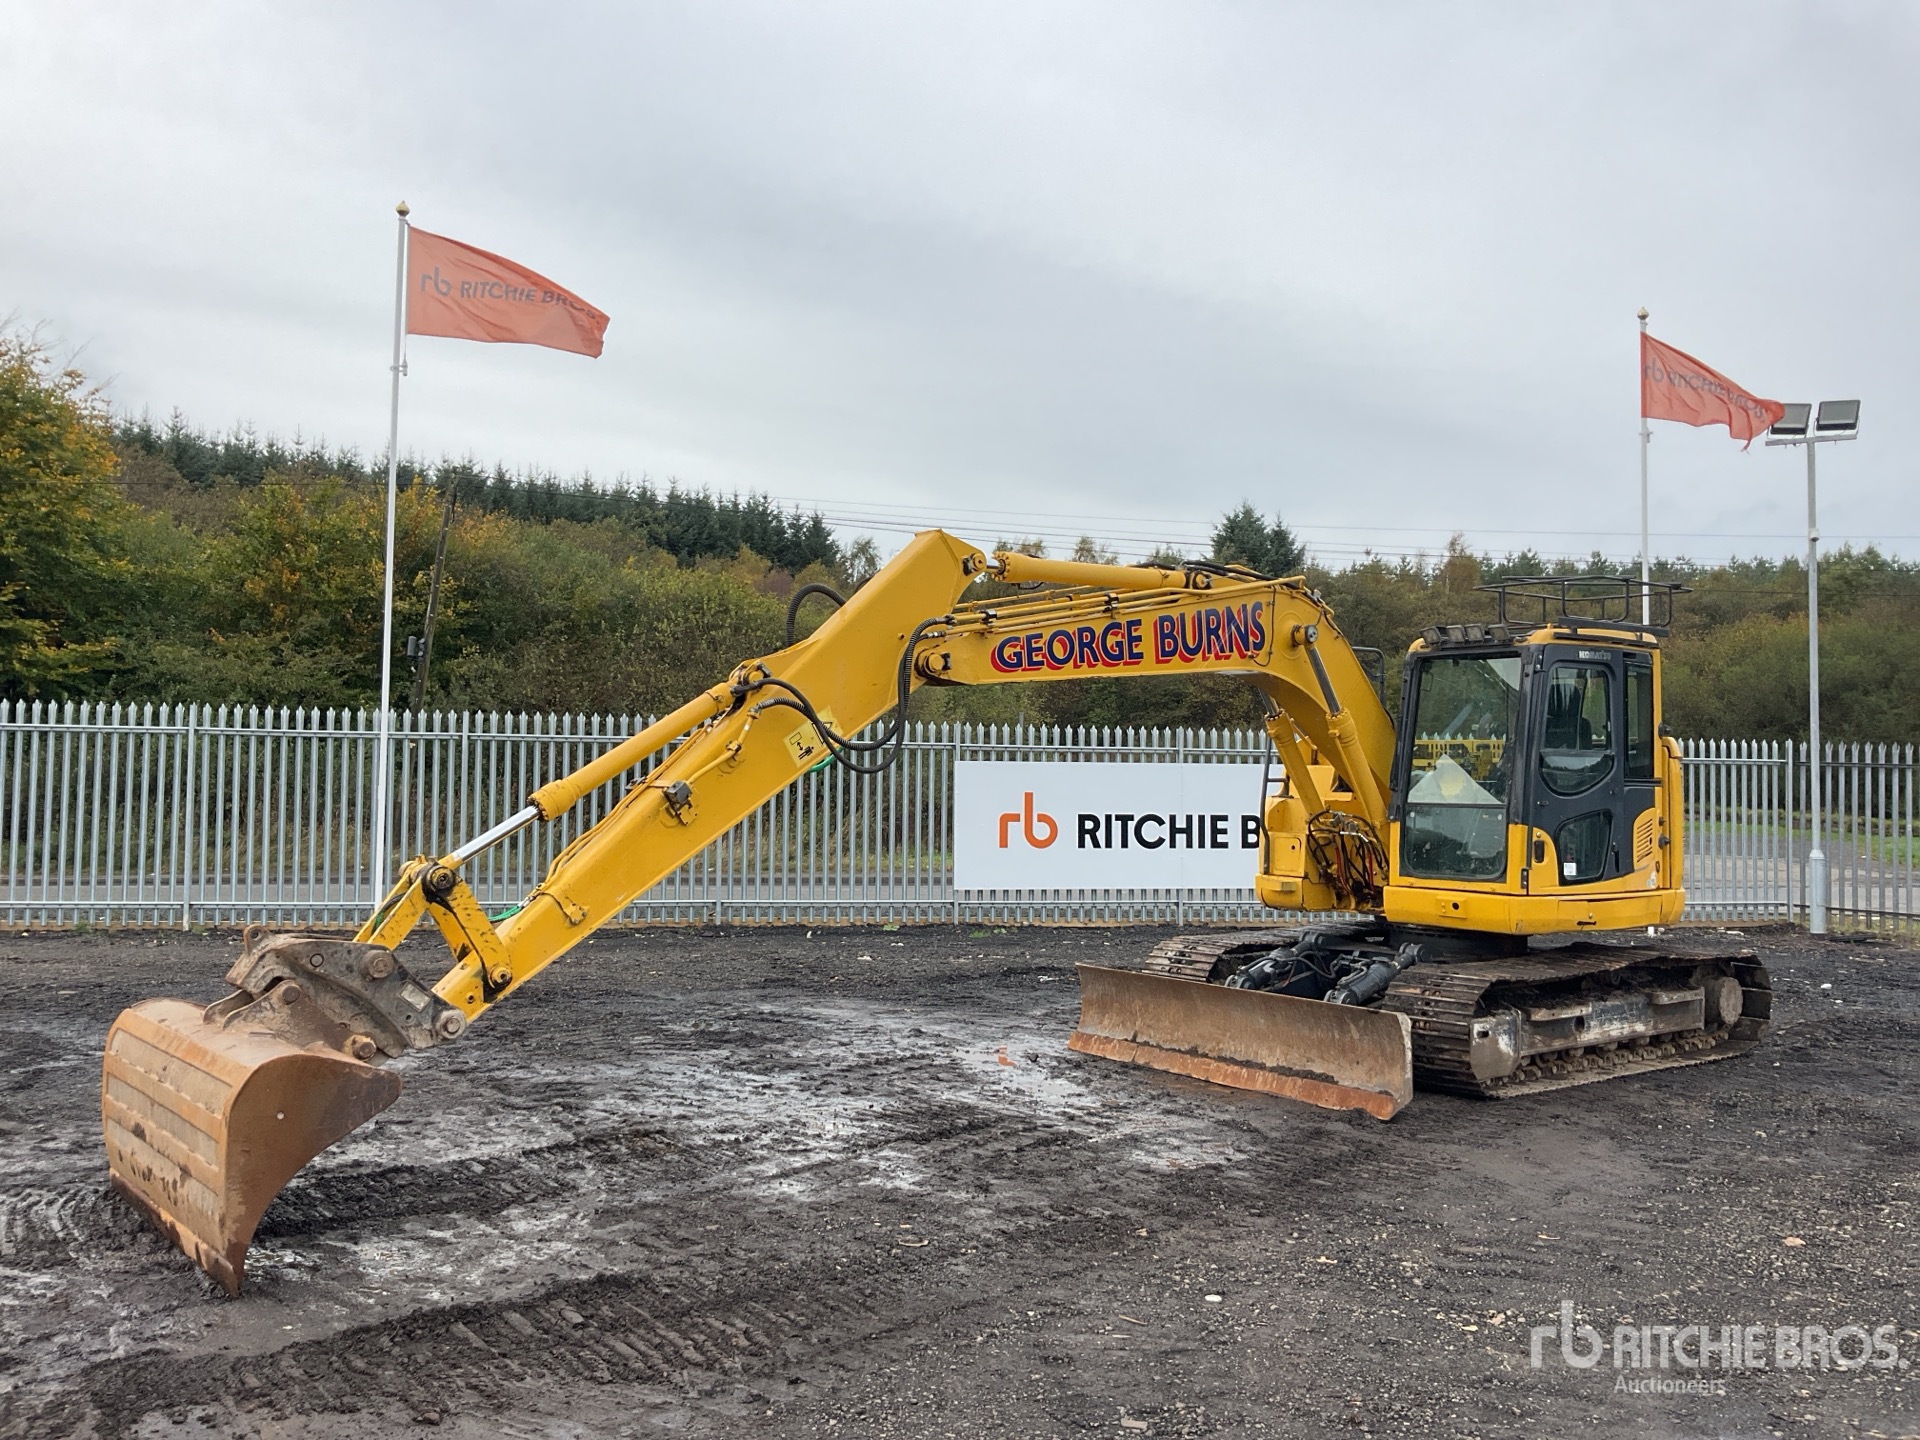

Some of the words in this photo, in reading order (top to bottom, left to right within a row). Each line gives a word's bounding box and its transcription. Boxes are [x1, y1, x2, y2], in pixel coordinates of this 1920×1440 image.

[420, 266, 452, 297] rb
[460, 280, 536, 303] RITCHIE
[1645, 358, 1664, 382] rb
[990, 618, 1144, 673] GEORGE
[1153, 601, 1266, 664] BURNS
[999, 792, 1058, 848] rb
[1077, 813, 1229, 849] RITCHIE
